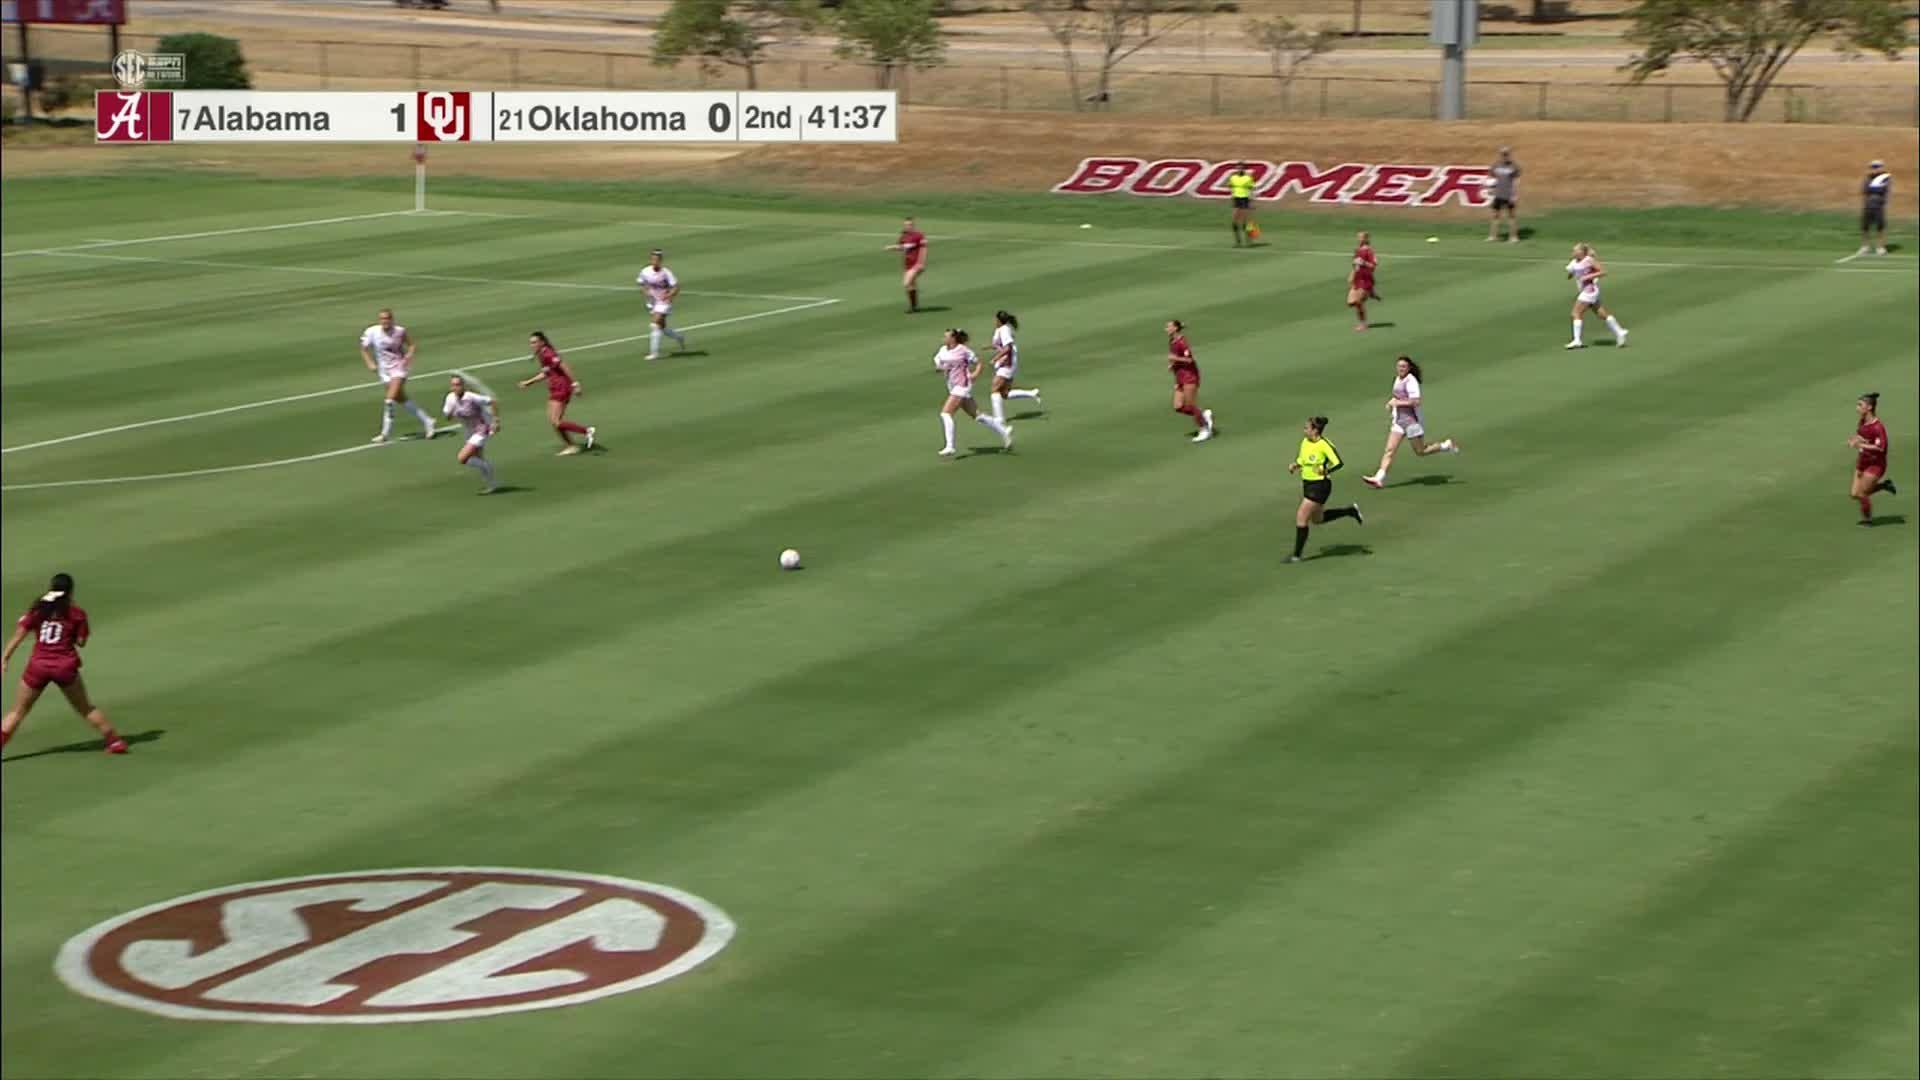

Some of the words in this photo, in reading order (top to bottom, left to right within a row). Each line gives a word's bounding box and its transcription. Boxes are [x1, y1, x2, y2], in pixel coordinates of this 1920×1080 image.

[1053, 158, 1495, 206] BOOMER
[39, 620, 63, 644] 10
[119, 879, 669, 1007] SEC
